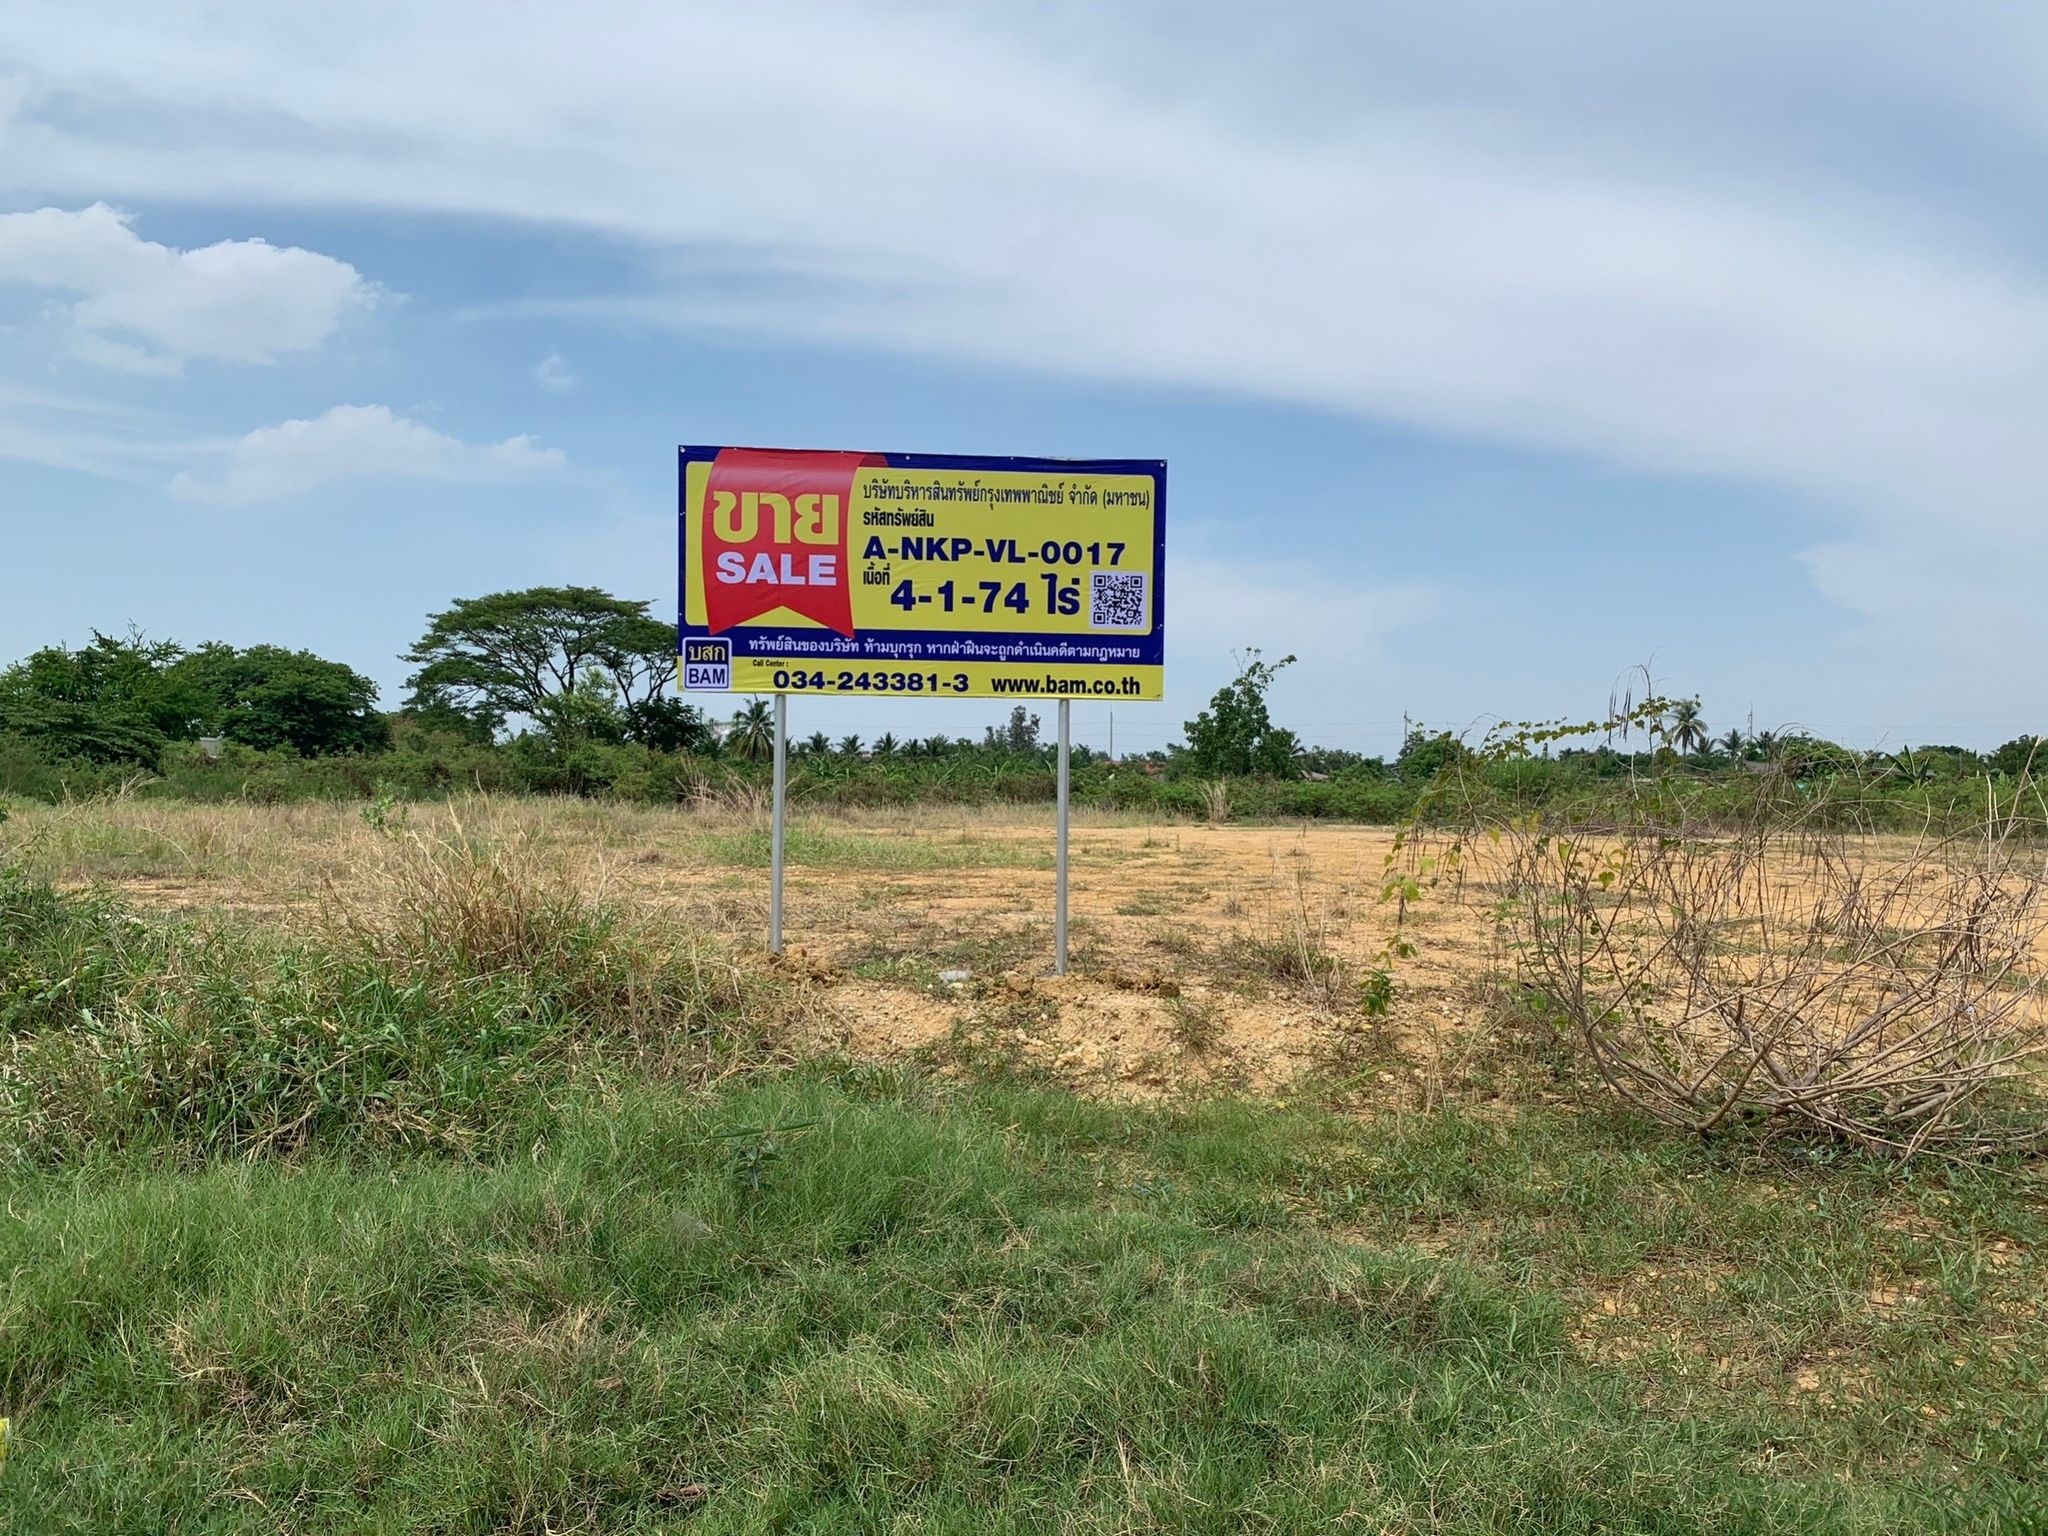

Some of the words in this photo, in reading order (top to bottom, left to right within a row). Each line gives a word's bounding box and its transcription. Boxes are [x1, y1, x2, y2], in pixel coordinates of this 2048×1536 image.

[863, 479, 1065, 510] บริษัทบริหารสินทรัพย์กรุงเทพพาณิชย์
[1069, 484, 1098, 506] จำกัด
[1103, 489, 1150, 510] (มหาชน)
[713, 491, 839, 545] ขาย
[863, 507, 934, 528] รหัสทรัพย์สิน
[863, 535, 1126, 565] A-NKP-VL-0017
[716, 551, 837, 586] SALE
[863, 562, 890, 586] เนื้อที่
[890, 579, 1030, 614] 4-1-74
[1041, 573, 1081, 615] ไร่
[688, 644, 726, 661] บสก
[749, 635, 860, 653] ทรัพย์สินของบริษัท
[865, 637, 922, 658] ห้ามบุกรุก
[752, 659, 764, 667] Call
[688, 668, 726, 684] BAM
[773, 670, 969, 693] 034-243381-3
[991, 675, 1141, 695] www.bam.co.th
